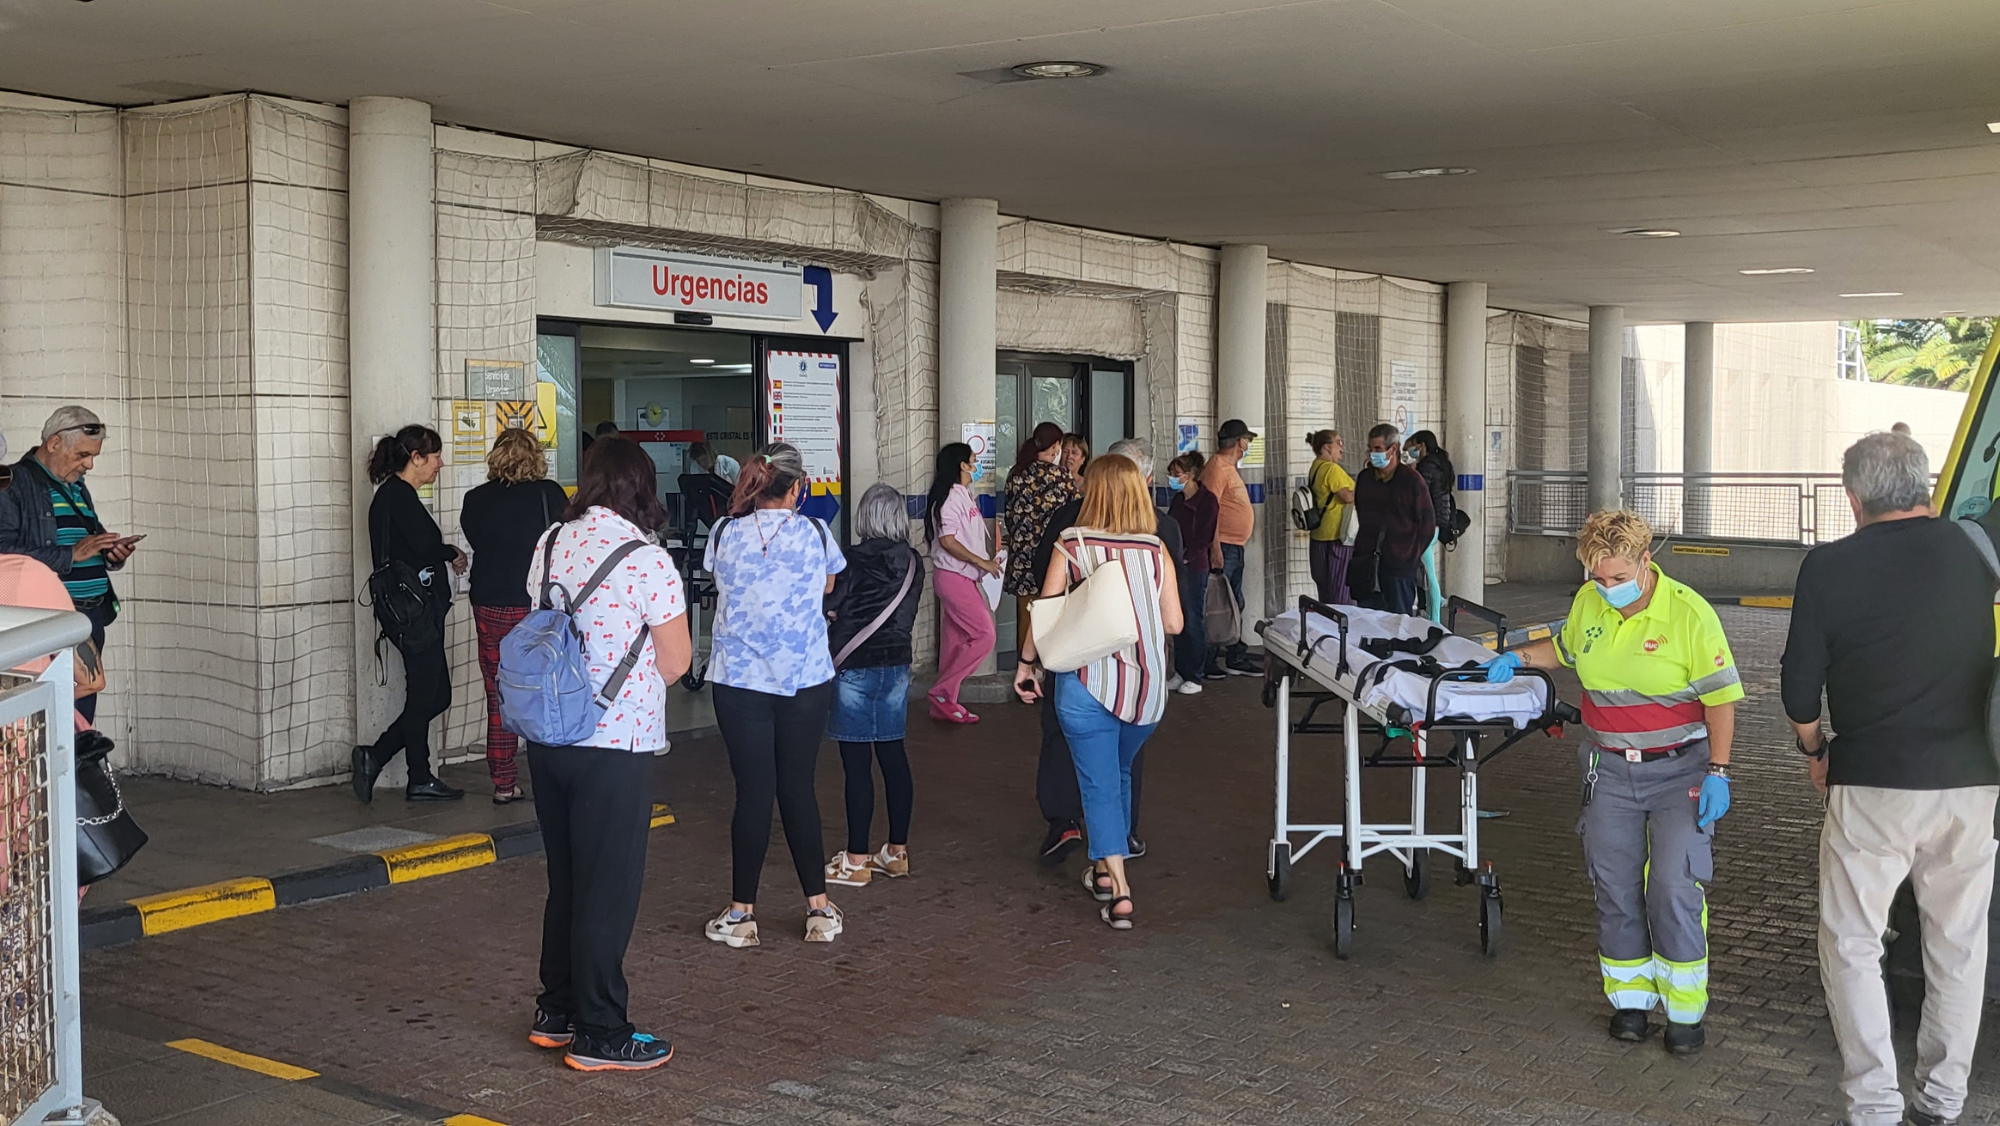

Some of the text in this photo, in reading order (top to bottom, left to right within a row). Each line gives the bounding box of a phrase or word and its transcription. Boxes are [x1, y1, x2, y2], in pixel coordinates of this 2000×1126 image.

[652, 264, 769, 306] Urgencias
[706, 431, 750, 440] ESTE CRISTAL ES
